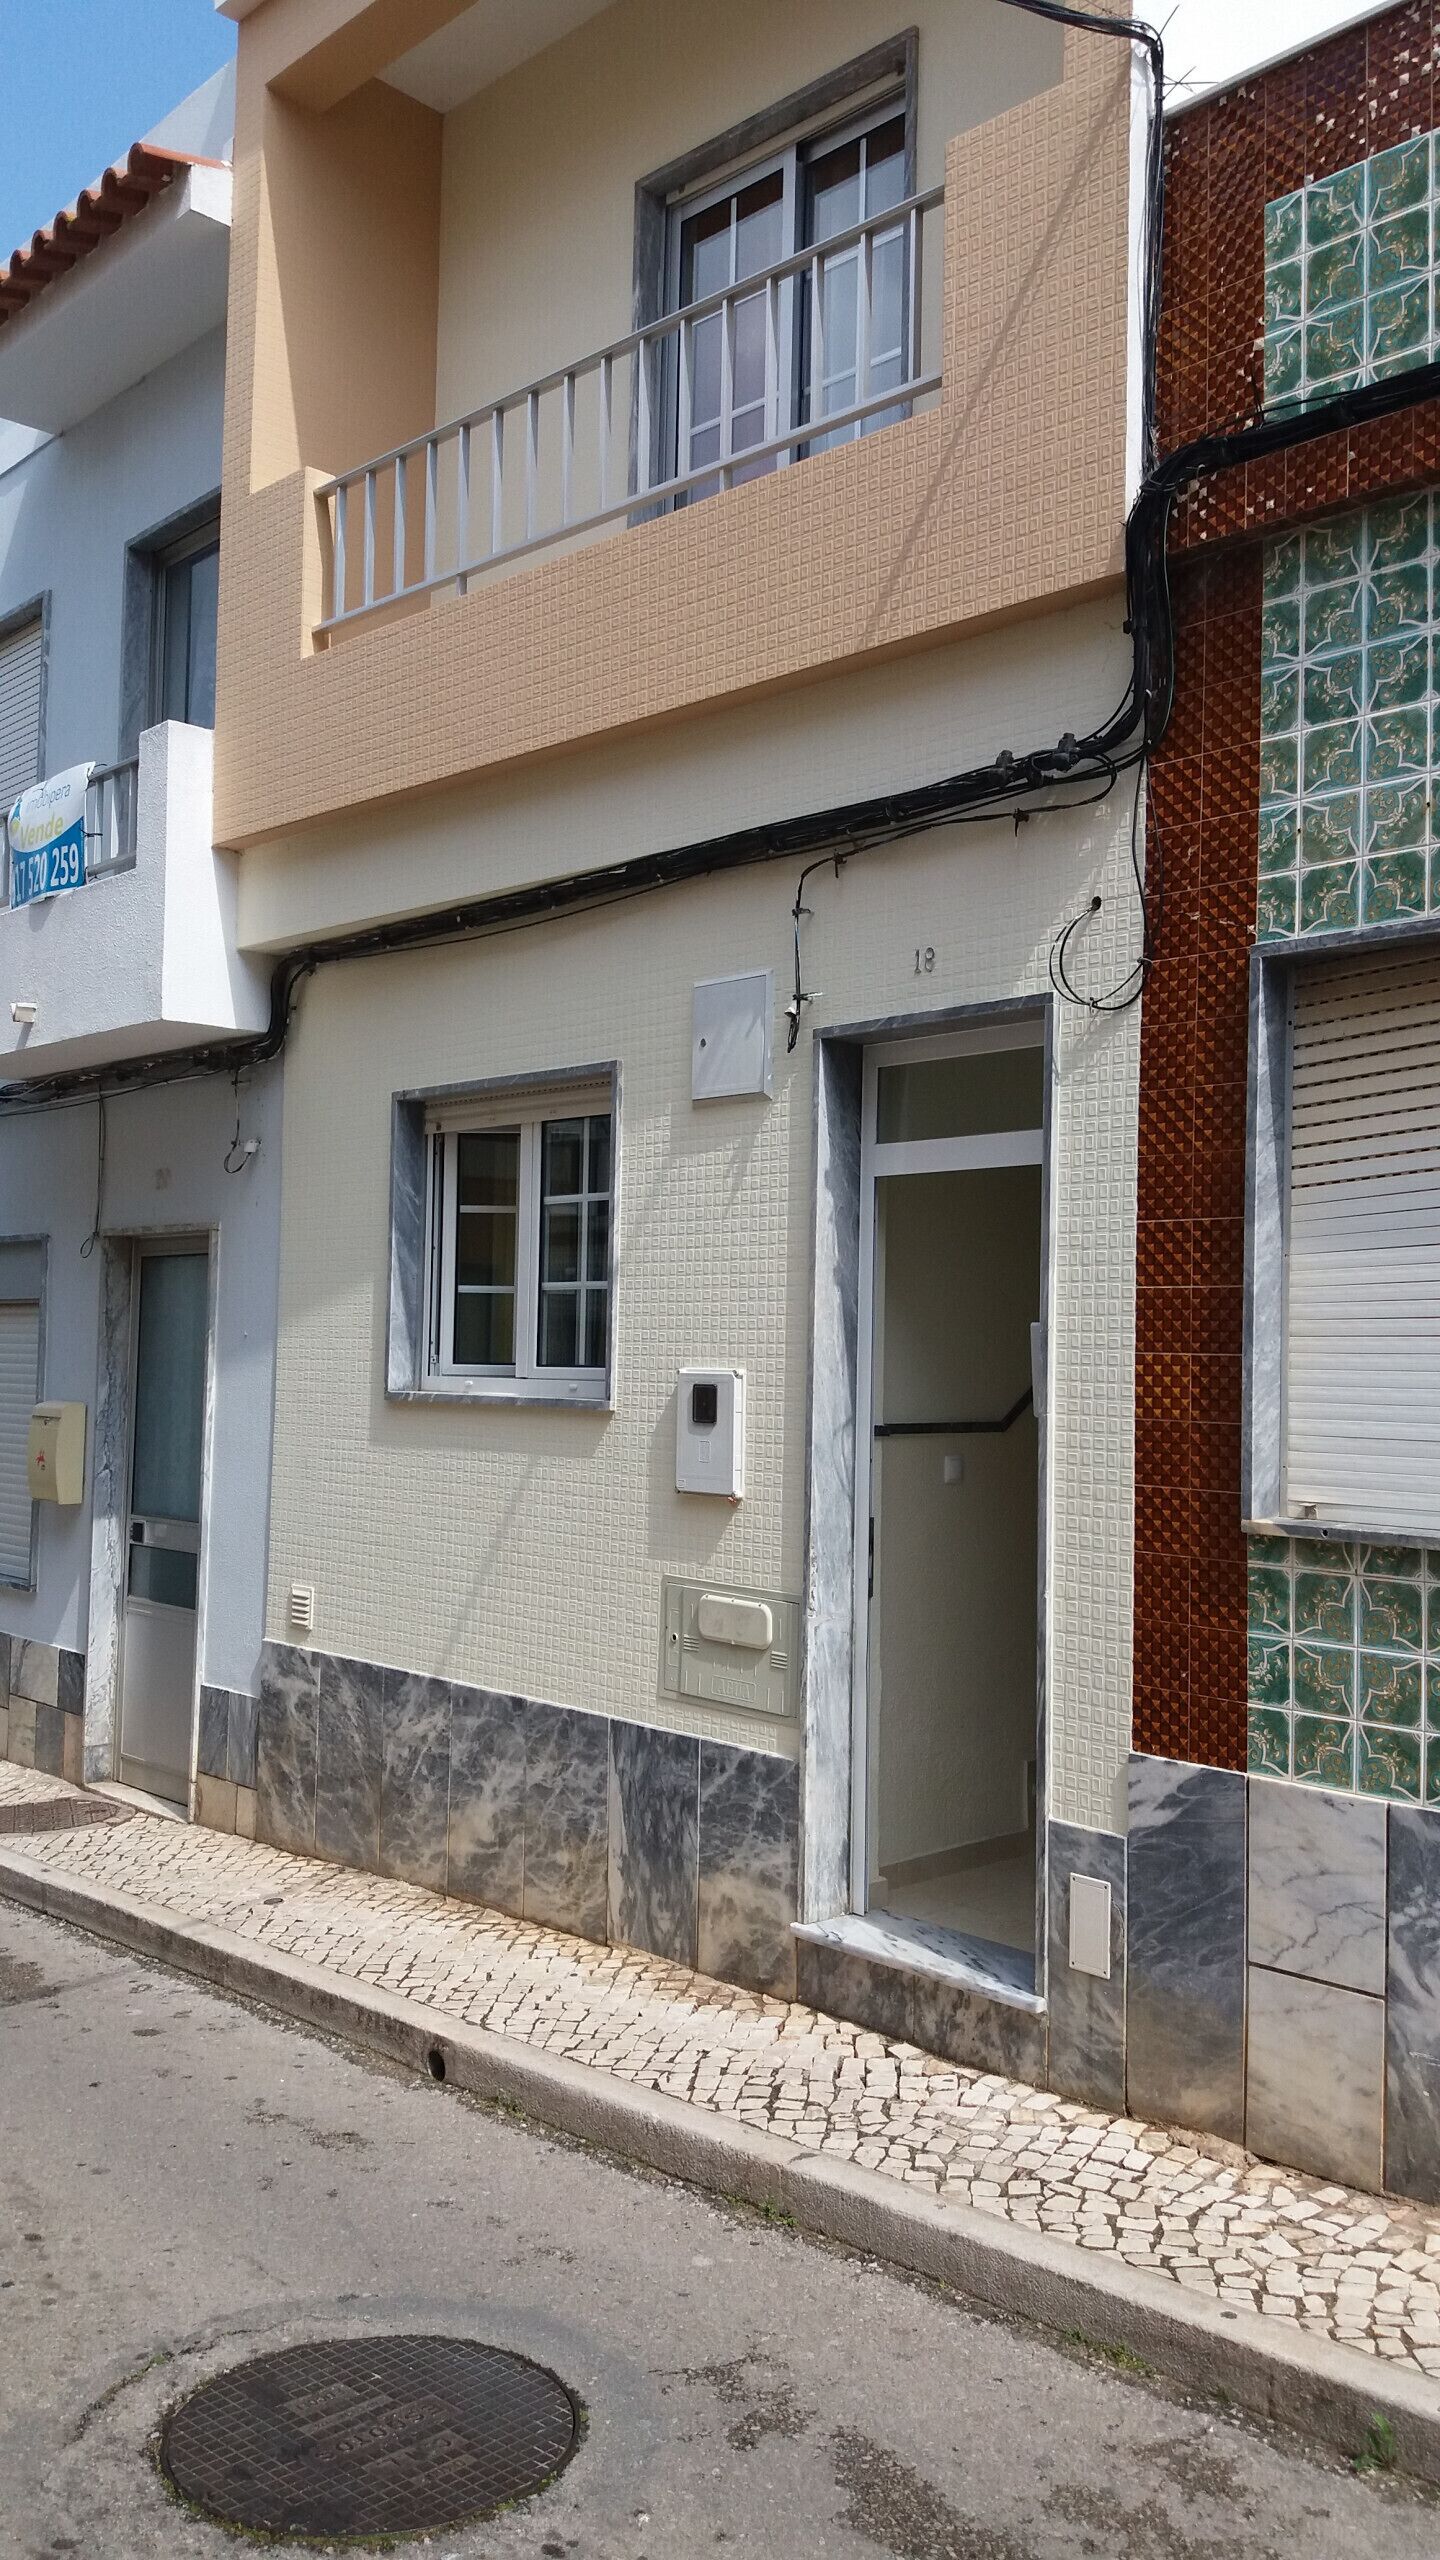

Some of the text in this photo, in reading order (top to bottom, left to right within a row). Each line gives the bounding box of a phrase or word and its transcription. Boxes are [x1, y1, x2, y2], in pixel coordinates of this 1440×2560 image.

[20, 811, 63, 849] Vende
[28, 851, 47, 896] 520
[50, 843, 79, 887] 259
[914, 946, 935, 975] 18
